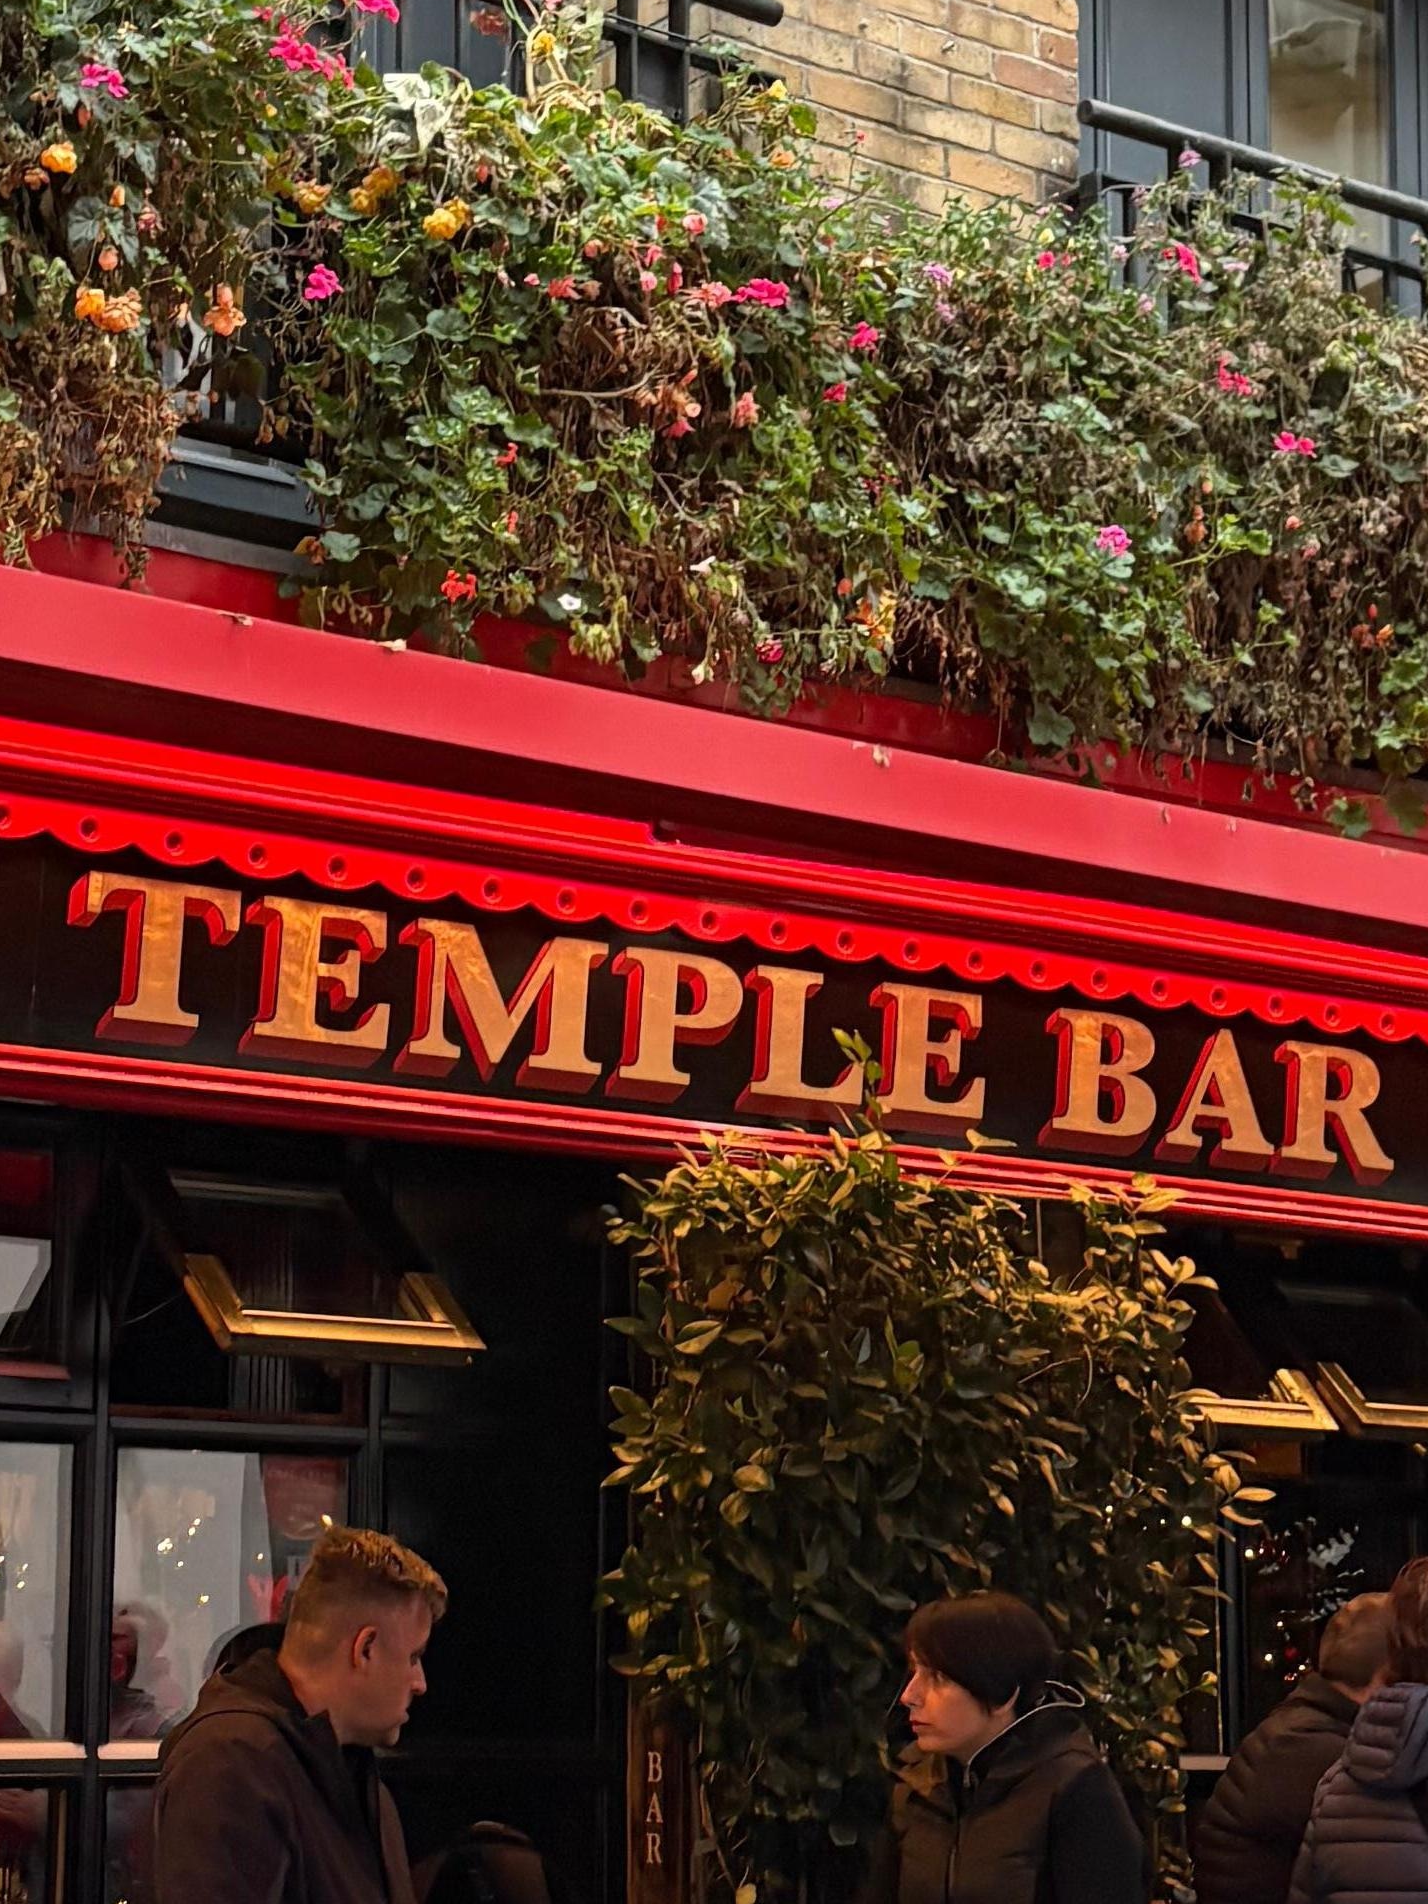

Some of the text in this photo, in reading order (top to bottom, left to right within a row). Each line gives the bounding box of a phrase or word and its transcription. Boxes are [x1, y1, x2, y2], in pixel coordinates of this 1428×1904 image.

[66, 868, 987, 1135] TEMPLE
[1036, 1006, 1396, 1188] BAR
[646, 1751, 663, 1864] BAR
